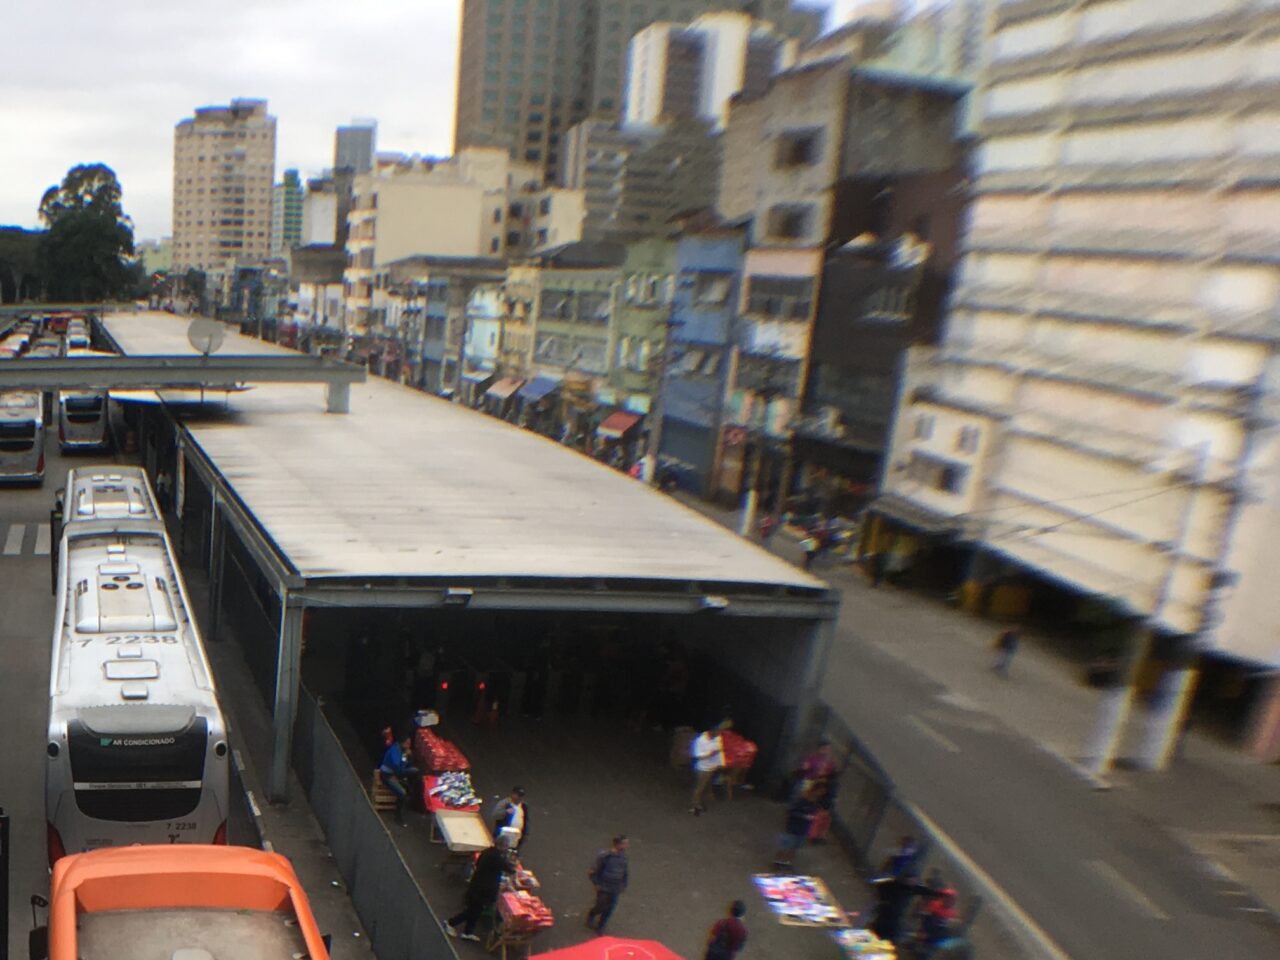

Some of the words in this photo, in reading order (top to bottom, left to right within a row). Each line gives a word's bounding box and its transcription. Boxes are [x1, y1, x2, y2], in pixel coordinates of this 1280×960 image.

[106, 635, 179, 646] 2238
[113, 738, 123, 746] AR
[124, 737, 176, 746] CONDICIONADO
